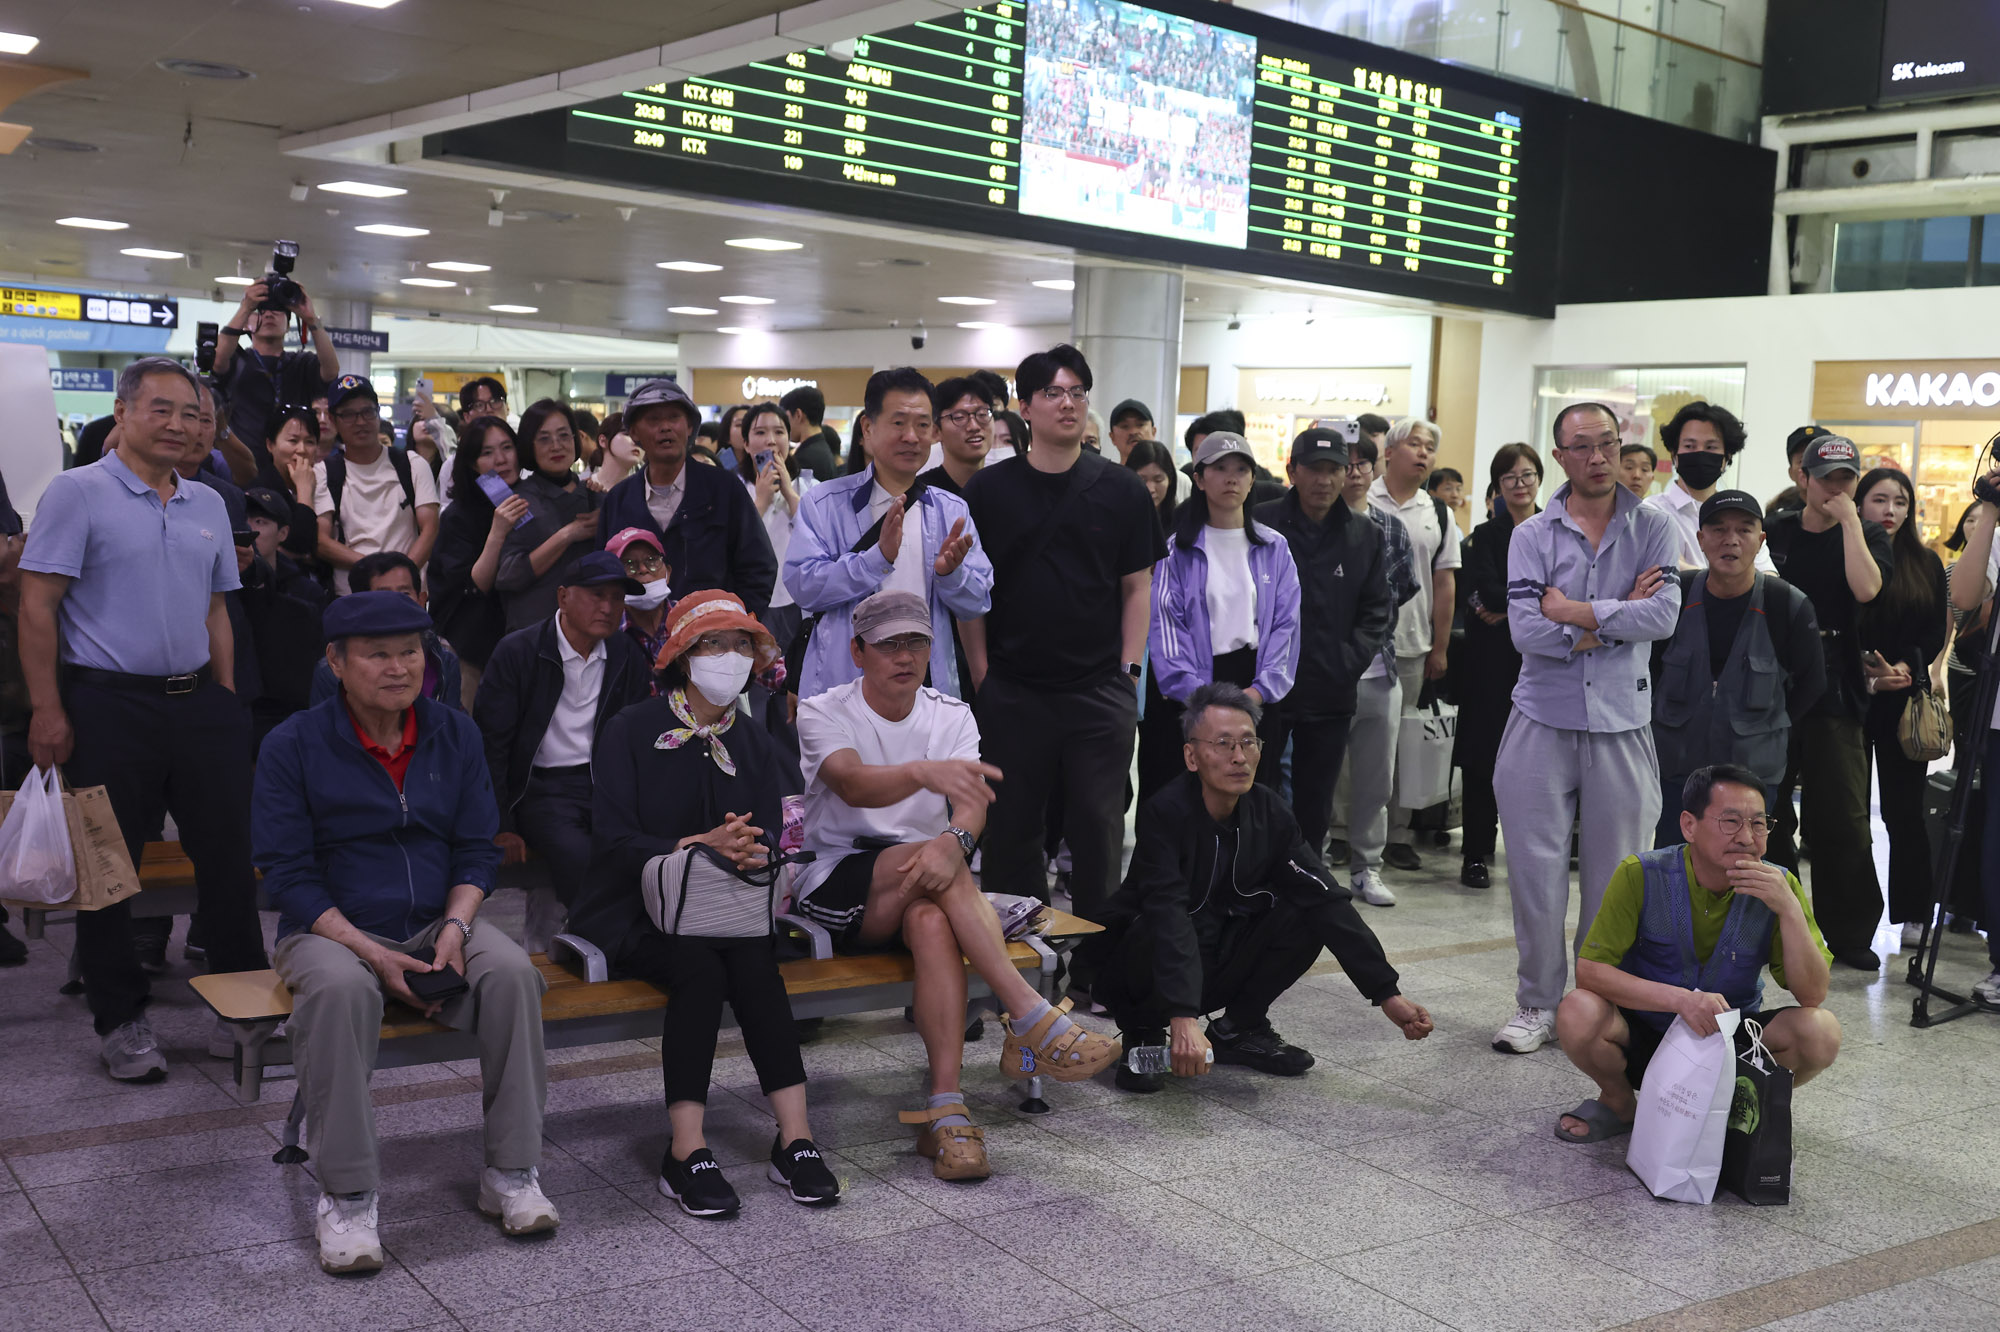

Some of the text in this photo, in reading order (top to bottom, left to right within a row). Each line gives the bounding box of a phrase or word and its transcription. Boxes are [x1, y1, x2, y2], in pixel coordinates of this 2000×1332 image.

[965, 17, 977, 31] 10
[966, 42, 974, 54] 4
[965, 66, 973, 79] 5
[1892, 61, 1965, 82] SK telecom
[683, 83, 707, 102] KTX
[682, 109, 707, 129] KTX
[681, 136, 707, 155] KTX
[1866, 371, 2000, 407] KAKAO
[794, 1149, 820, 1162] FILA
[691, 1160, 719, 1175] FILA
